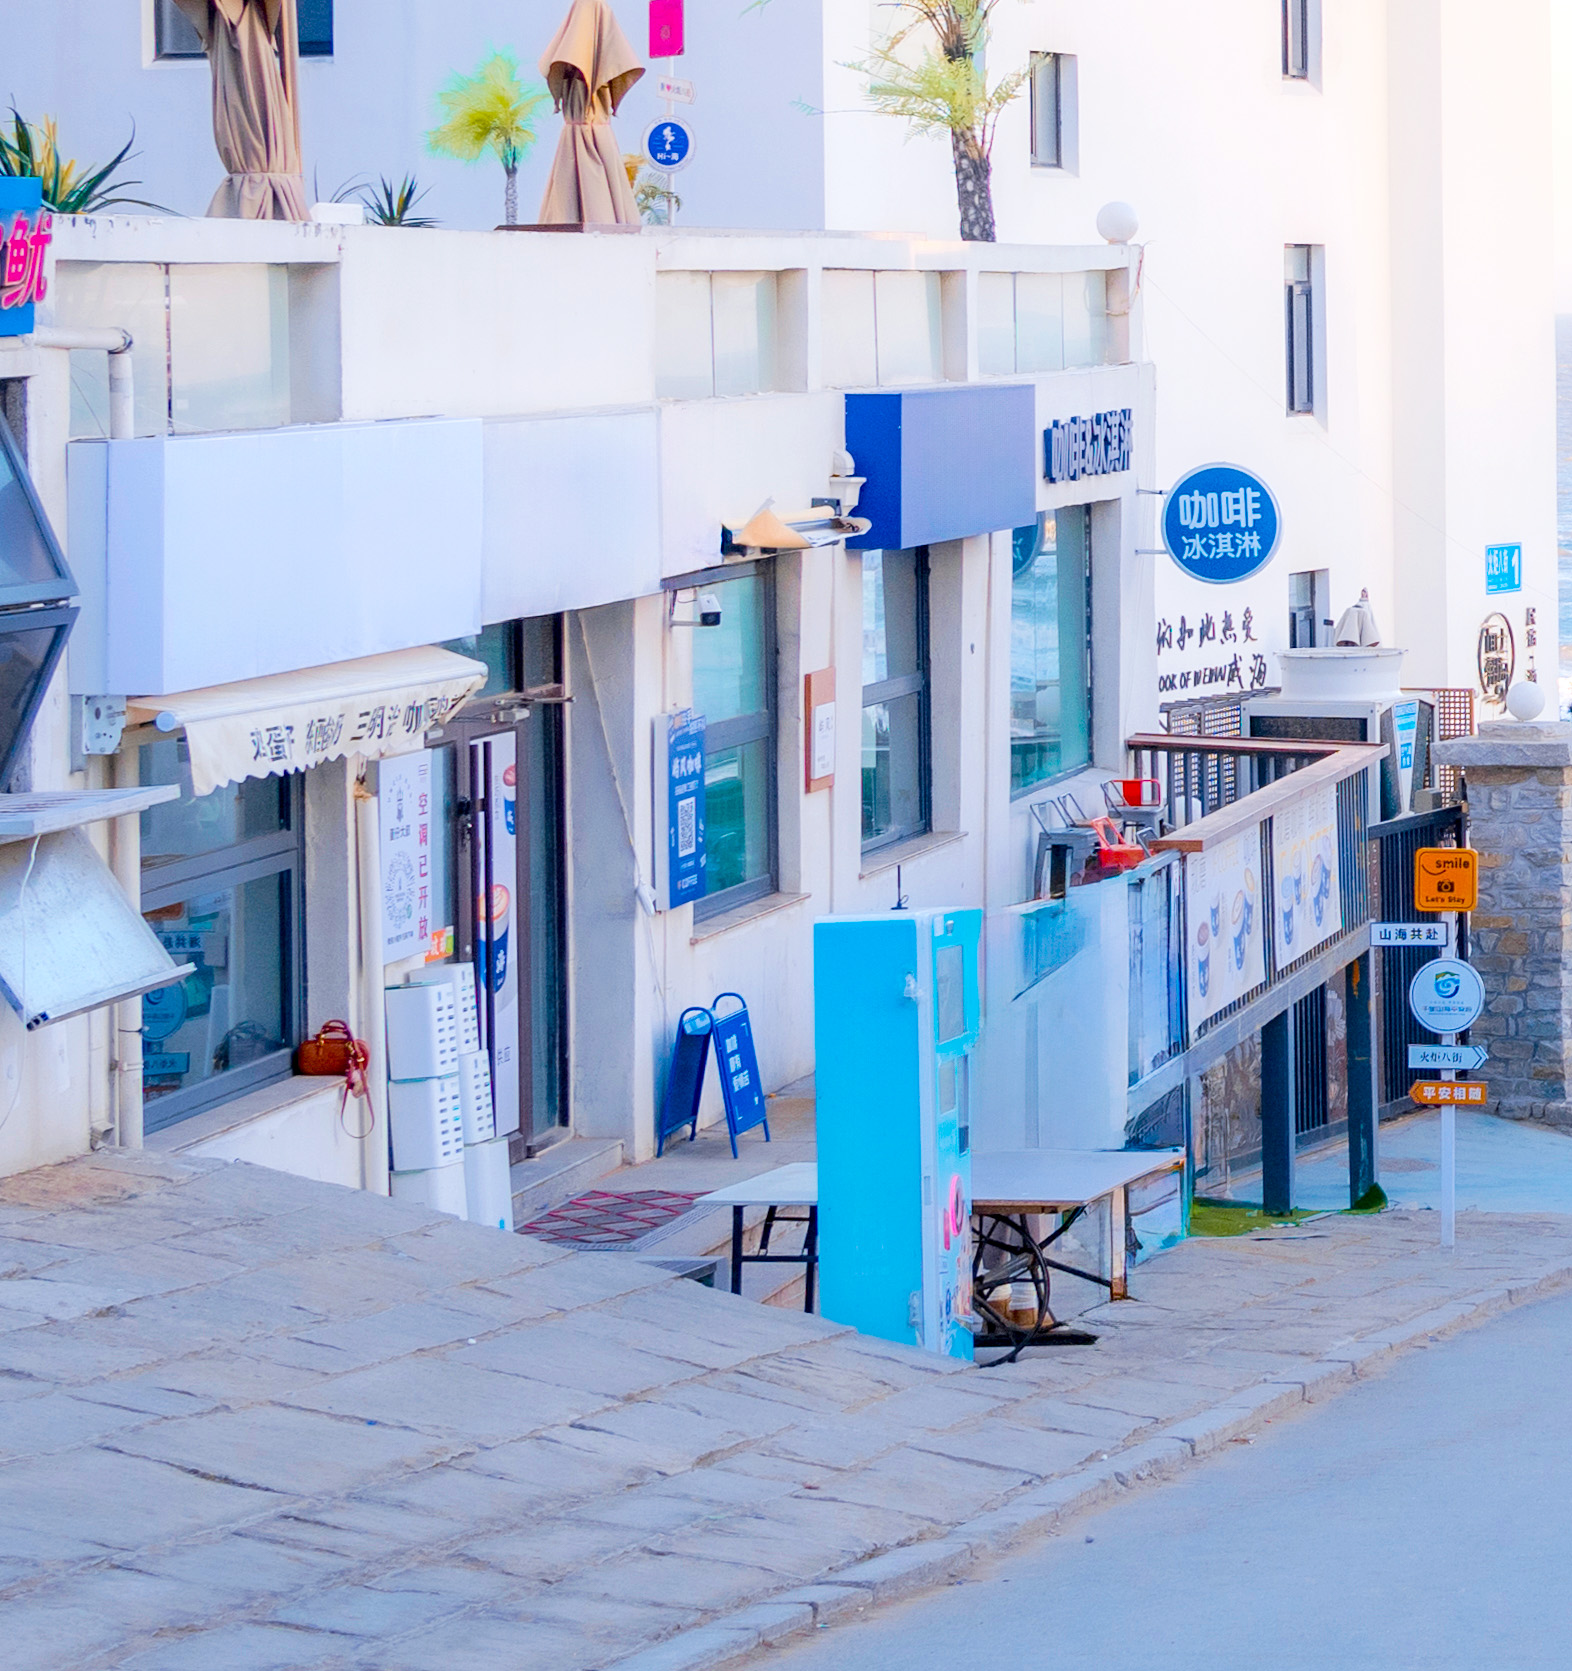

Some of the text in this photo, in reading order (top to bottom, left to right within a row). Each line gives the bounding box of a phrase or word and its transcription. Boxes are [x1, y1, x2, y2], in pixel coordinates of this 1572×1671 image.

[0, 210, 52, 309] 鱿
[1043, 408, 1134, 484] 咖啡&冰淇淋
[1179, 487, 1262, 529] 咖啡
[1181, 531, 1262, 559] 冰淇淋
[1511, 549, 1520, 585] 1
[1179, 671, 1192, 689] OF
[350, 704, 400, 741] 三明治
[418, 792, 429, 940] 空调已开放
[1435, 857, 1470, 869] smile
[1379, 927, 1439, 941] 山海共赴
[1419, 1050, 1464, 1064] 火炬八街
[1422, 1085, 1483, 1101] 平安相随
